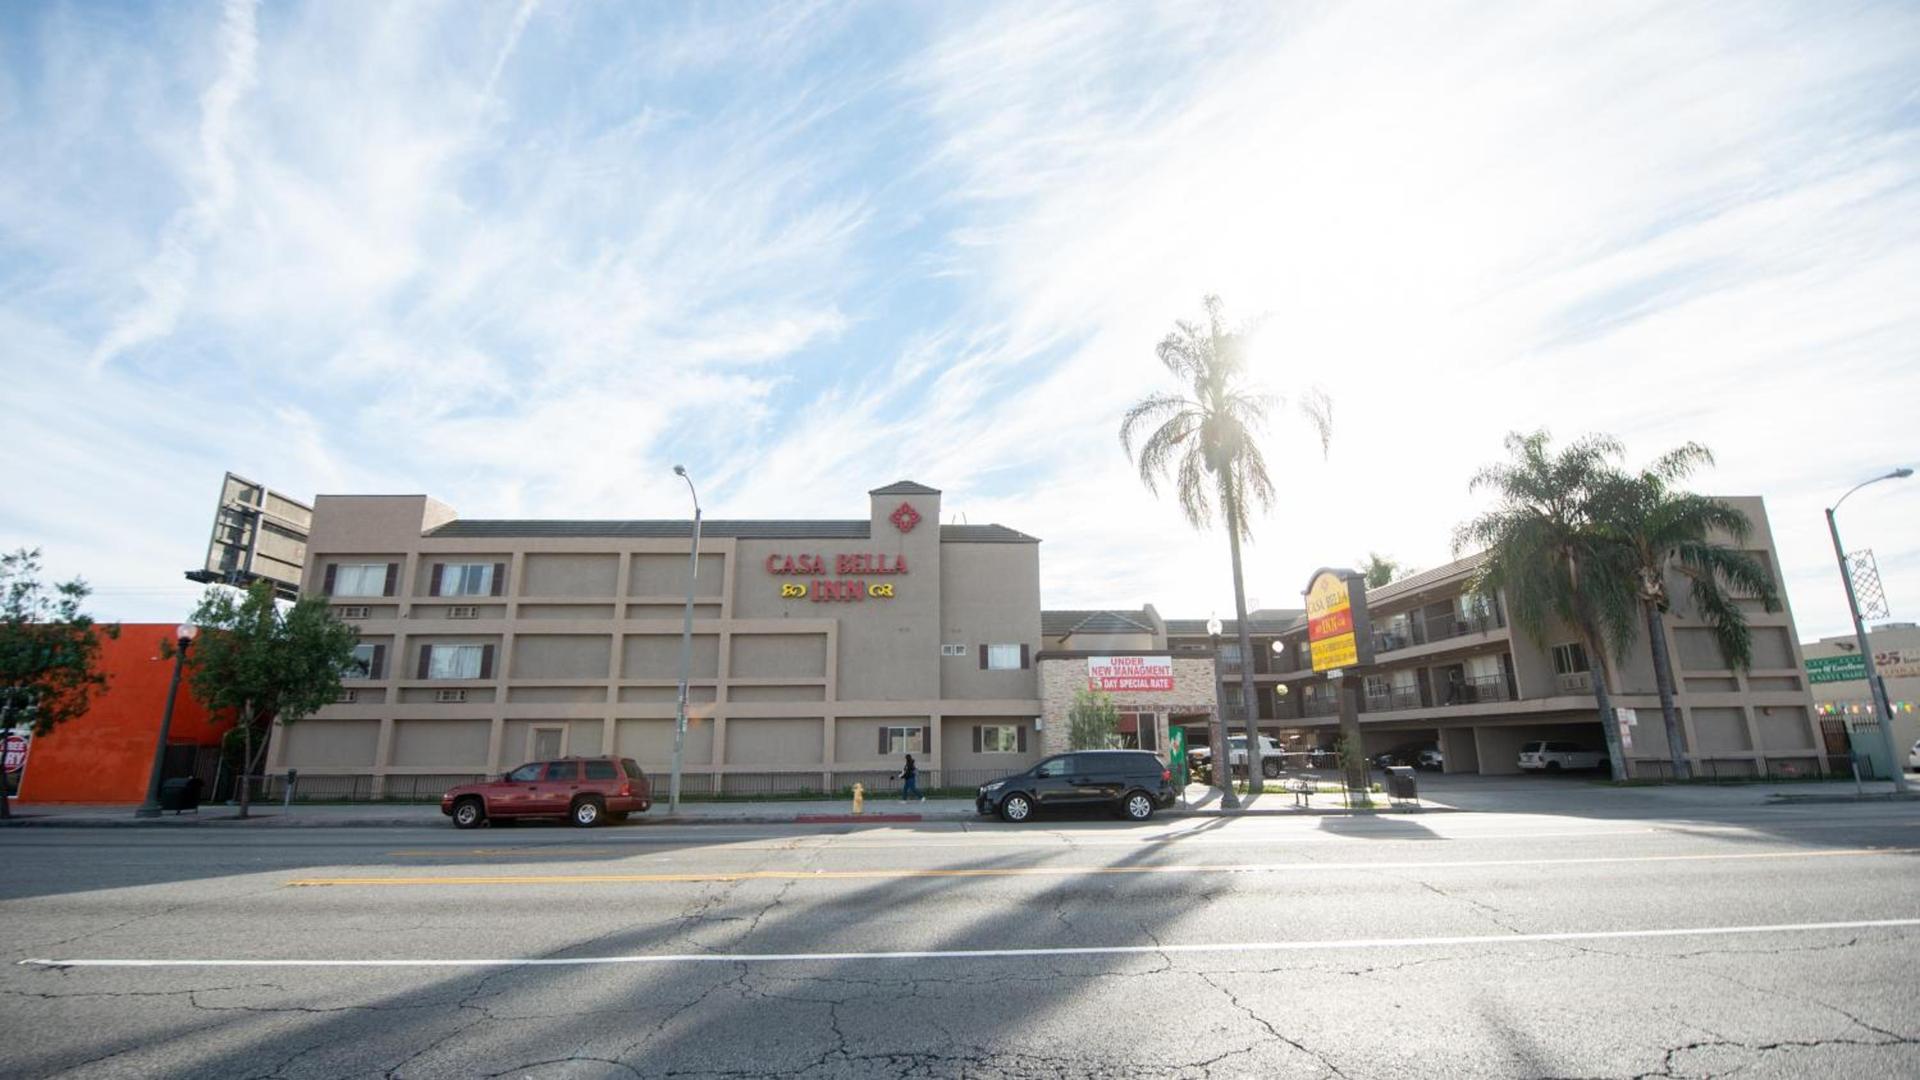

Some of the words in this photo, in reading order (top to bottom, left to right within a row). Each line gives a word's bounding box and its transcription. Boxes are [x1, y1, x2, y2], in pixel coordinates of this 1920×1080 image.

[766, 554, 826, 575] CASA
[836, 554, 908, 575] BELLA
[811, 580, 864, 602] INN
[1110, 657, 1144, 666] UNDER
[1876, 651, 1900, 665] 25
[1091, 666, 1111, 676] NEW
[1113, 665, 1169, 675] MANAGMENT
[1104, 679, 1117, 688] DAY
[1119, 679, 1149, 688] SPECIAL
[1150, 679, 1169, 688] RATE
